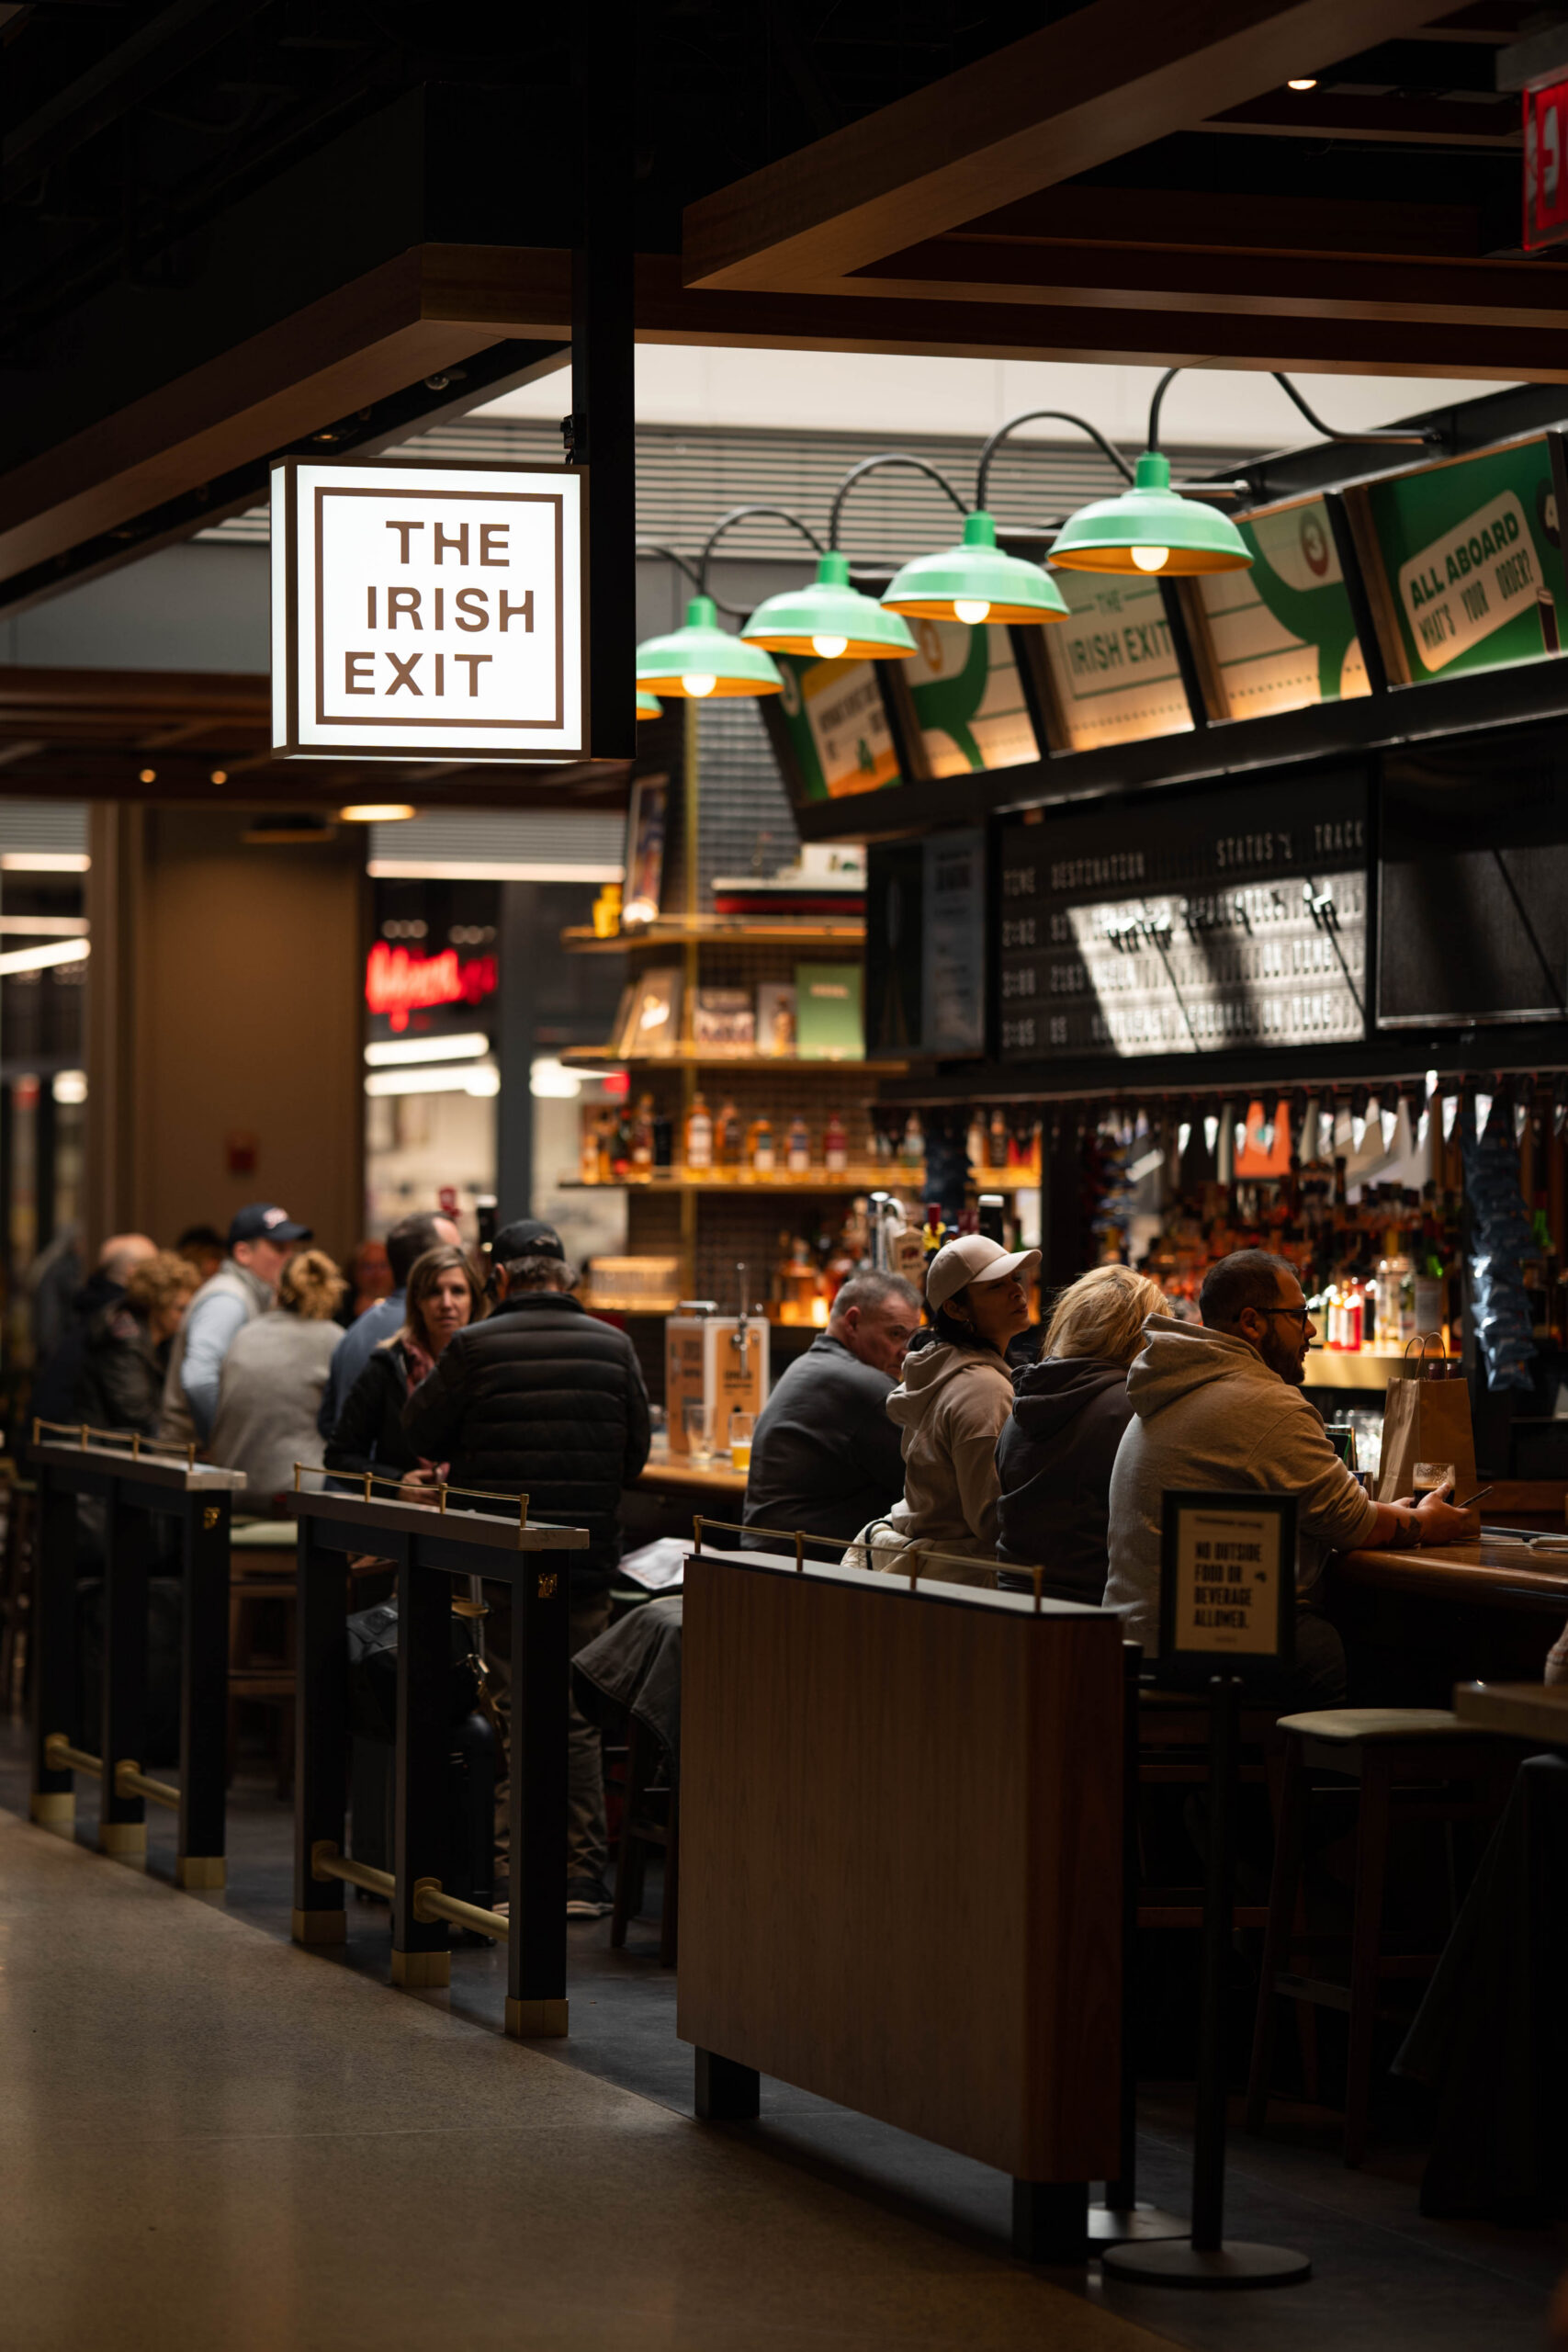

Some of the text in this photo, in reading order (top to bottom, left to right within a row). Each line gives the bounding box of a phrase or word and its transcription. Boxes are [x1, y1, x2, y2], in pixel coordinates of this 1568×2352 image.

[385, 520, 510, 568] THE
[1305, 523, 1323, 562] 3
[1409, 512, 1520, 611] ALL ABOARD
[367, 585, 535, 633] IRISH
[1095, 589, 1123, 616] THE
[1418, 548, 1535, 652] WHAT'S YOUR ORDER?
[1067, 620, 1171, 675] IRISH EXIT
[344, 650, 493, 697] EXIT
[1216, 831, 1274, 867] STATUS
[1314, 819, 1363, 853] TRACK
[1195, 1542, 1261, 1562] NO OUTSIDE
[1195, 1564, 1242, 1583] FOOD OR
[1194, 1587, 1252, 1606] BEVERAGE
[1194, 1610, 1249, 1629] ALLOWED.
